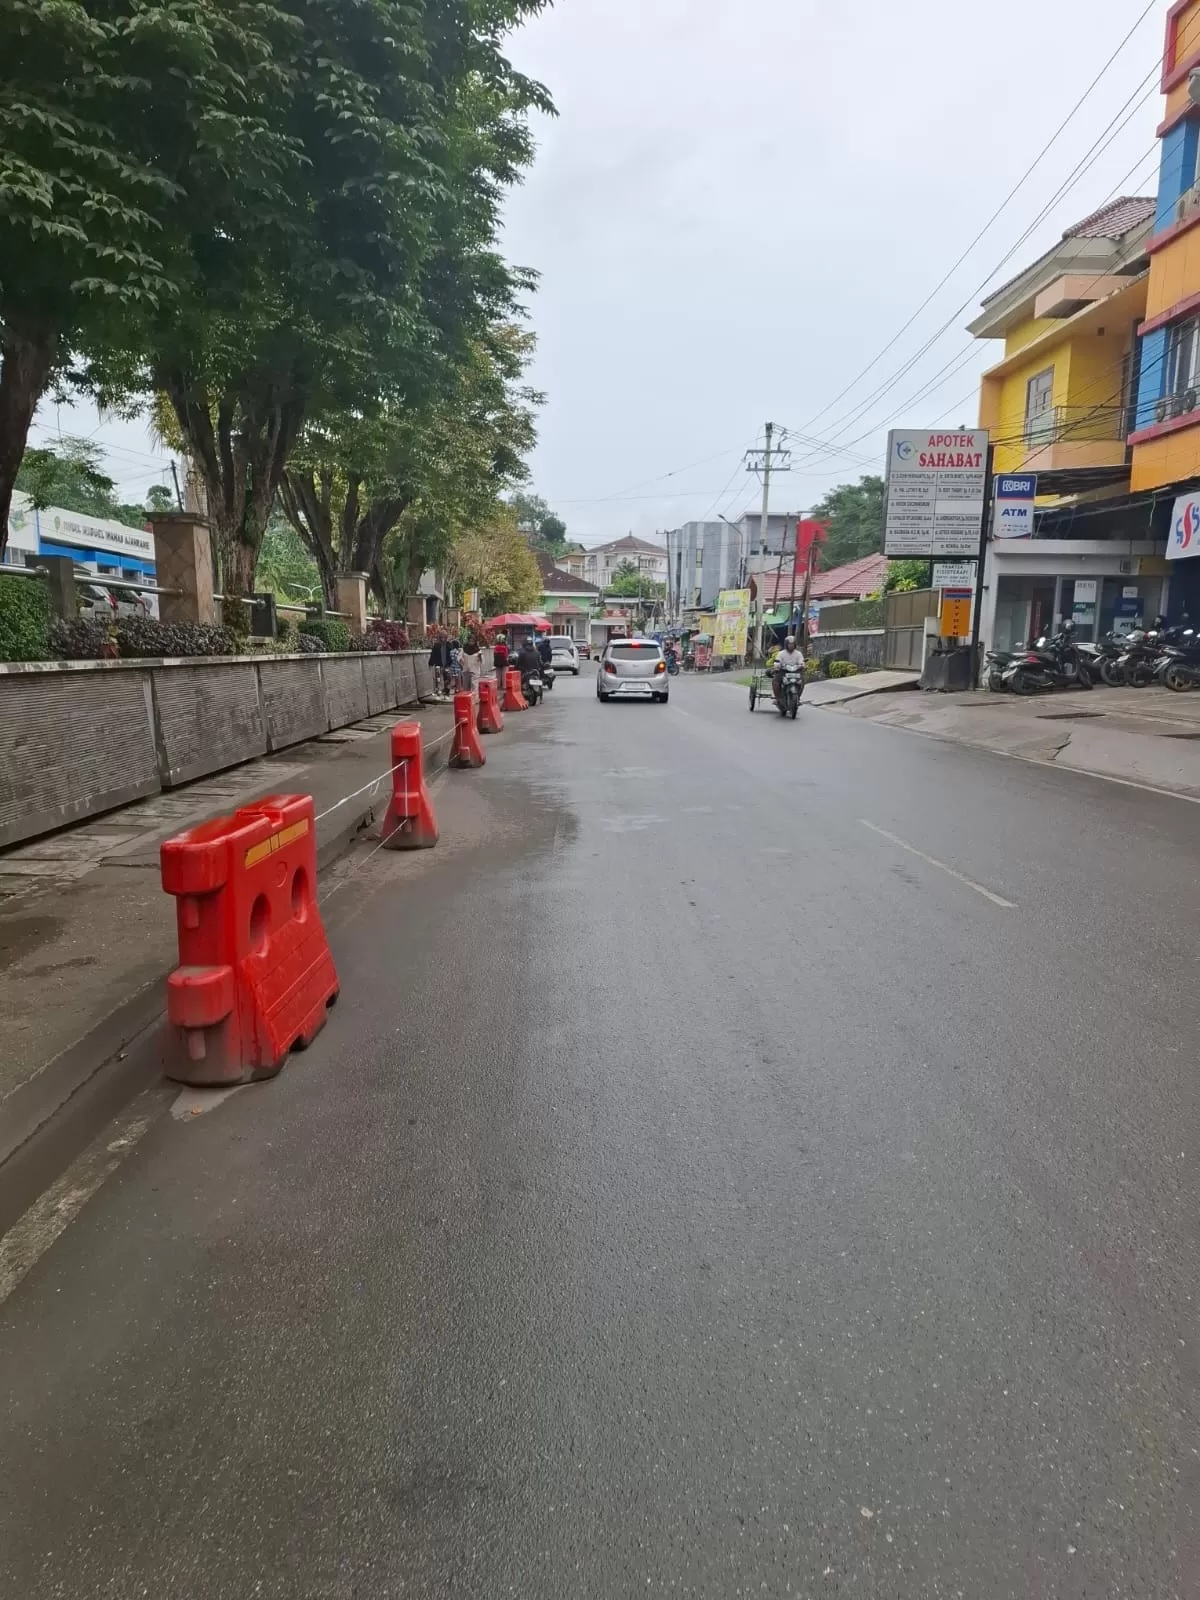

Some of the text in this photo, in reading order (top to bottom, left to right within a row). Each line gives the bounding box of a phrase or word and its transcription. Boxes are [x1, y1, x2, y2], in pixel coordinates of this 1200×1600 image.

[928, 435, 975, 447] APOTEK
[919, 452, 983, 467] SAHABAT
[1013, 481, 1031, 492] BRI
[1001, 508, 1027, 517] ATM
